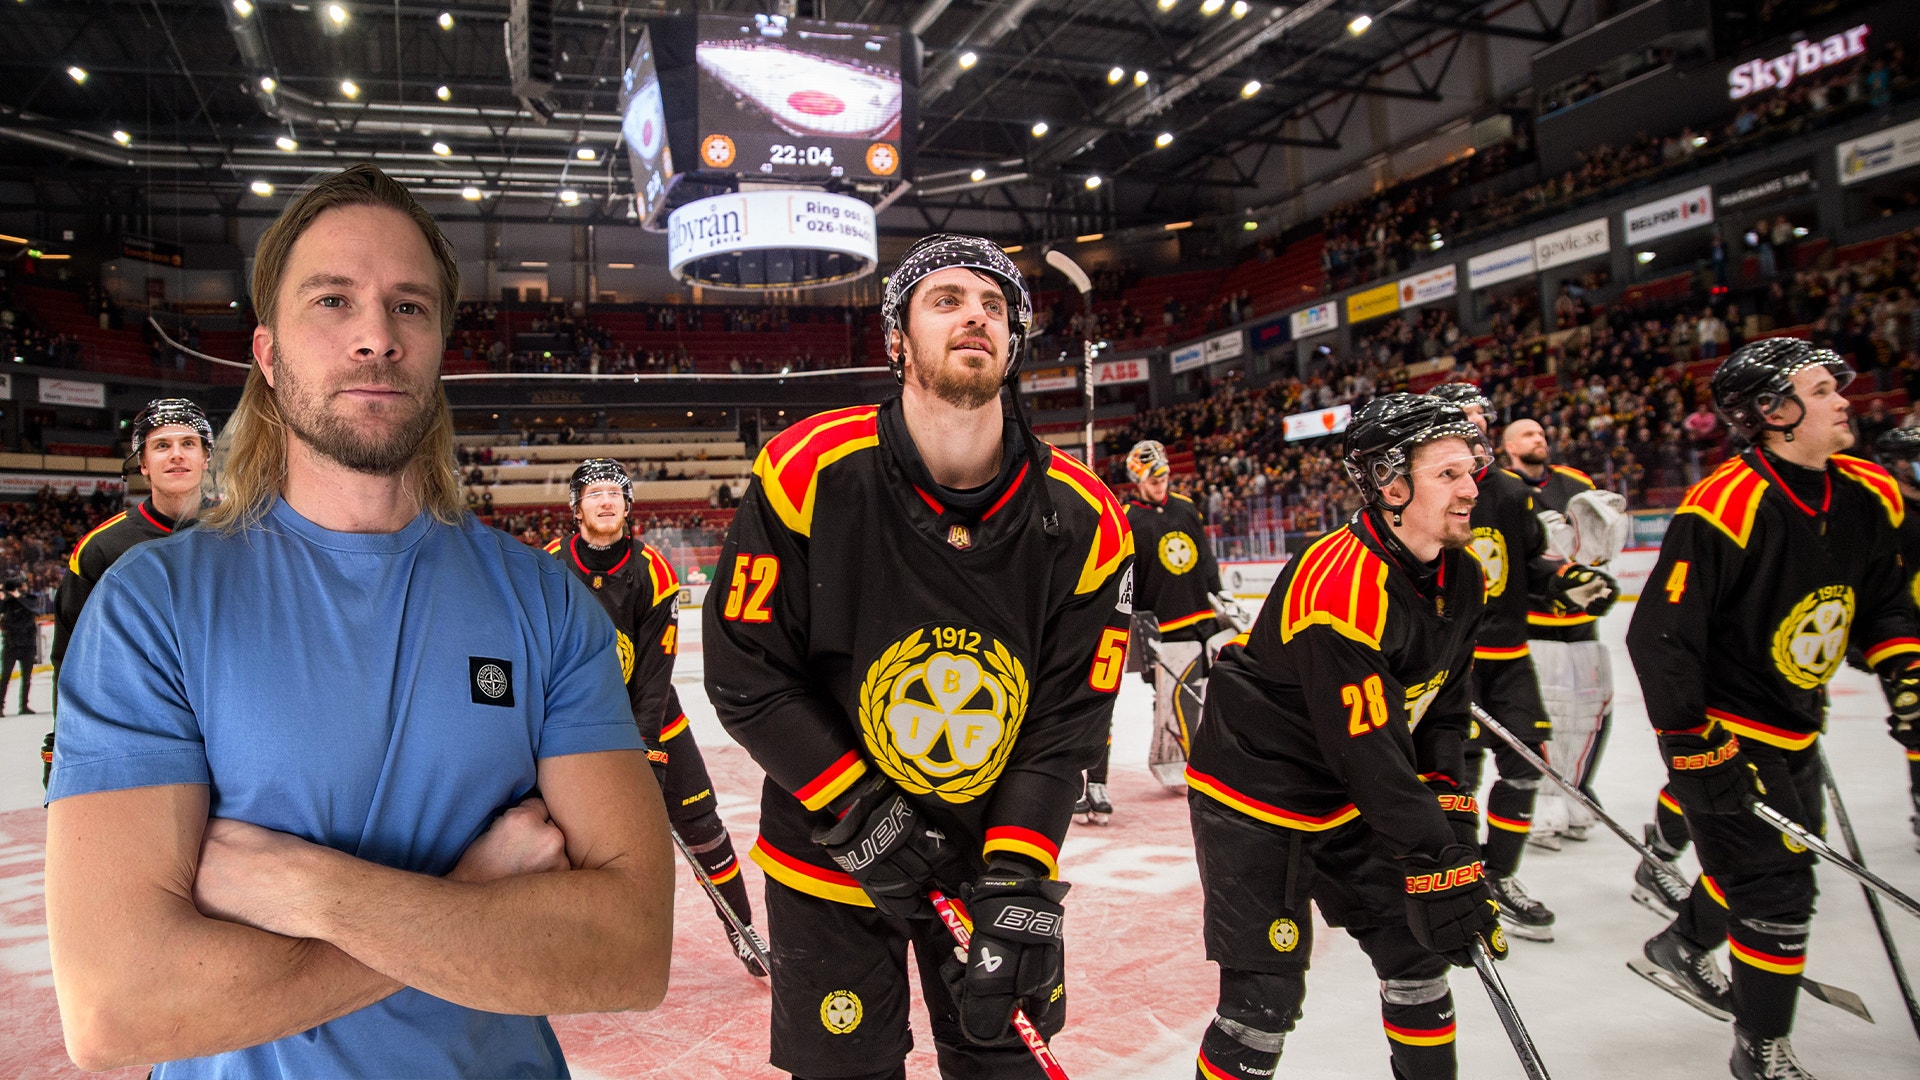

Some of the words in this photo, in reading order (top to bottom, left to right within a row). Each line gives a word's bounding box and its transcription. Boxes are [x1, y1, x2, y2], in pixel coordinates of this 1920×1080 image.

[1729, 24, 1871, 99] Skybar
[770, 144, 834, 167] 22:04
[806, 201, 840, 218] Ring
[1630, 207, 1679, 232] BELFOR
[1101, 362, 1139, 382] ABB
[723, 553, 781, 624] 52
[1664, 560, 1690, 604] 4
[1818, 585, 1845, 601] 1912
[931, 627, 982, 654] 1912
[941, 668, 961, 694] B
[1340, 672, 1389, 738] 28
[909, 716, 919, 739] I
[963, 724, 984, 749] F
